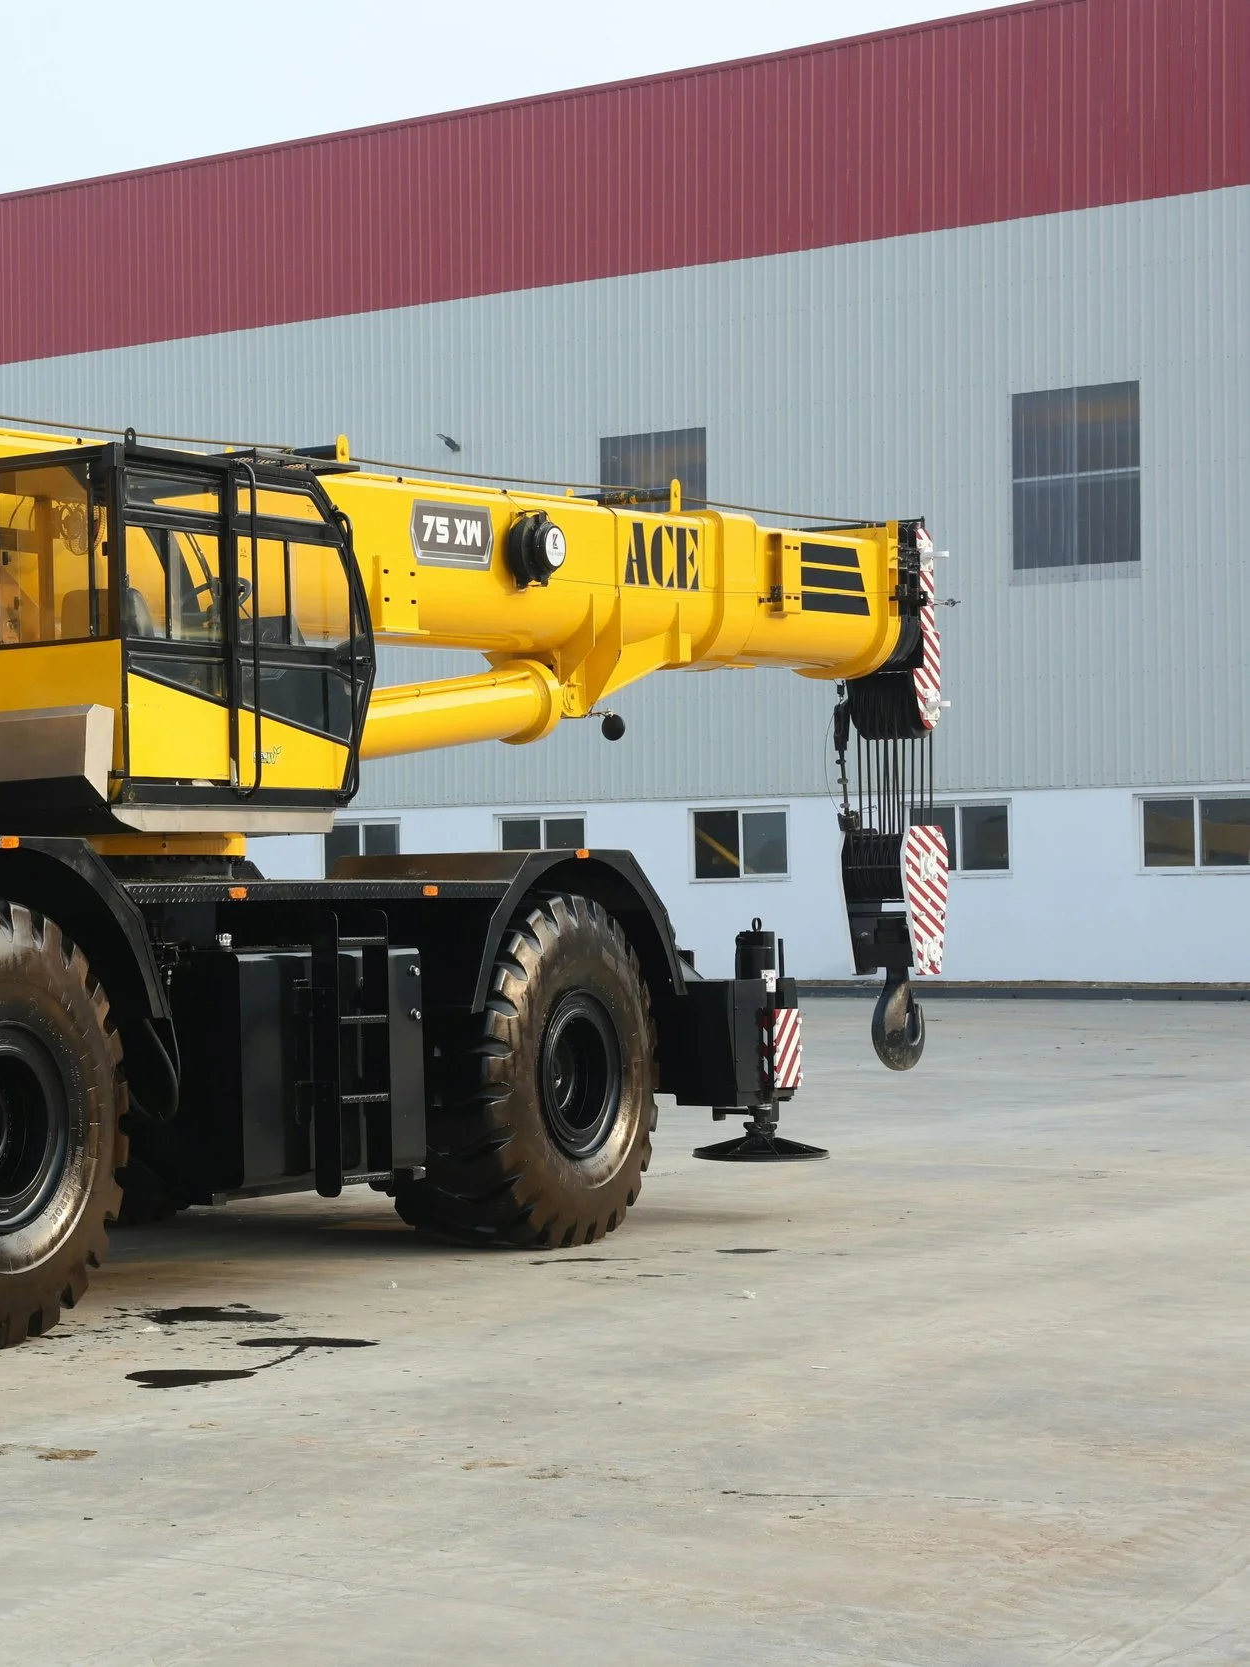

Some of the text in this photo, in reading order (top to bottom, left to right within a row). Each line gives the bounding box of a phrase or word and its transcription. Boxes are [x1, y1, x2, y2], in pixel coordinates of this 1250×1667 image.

[422, 514, 482, 547] 75 XW
[624, 522, 700, 591] ACE
